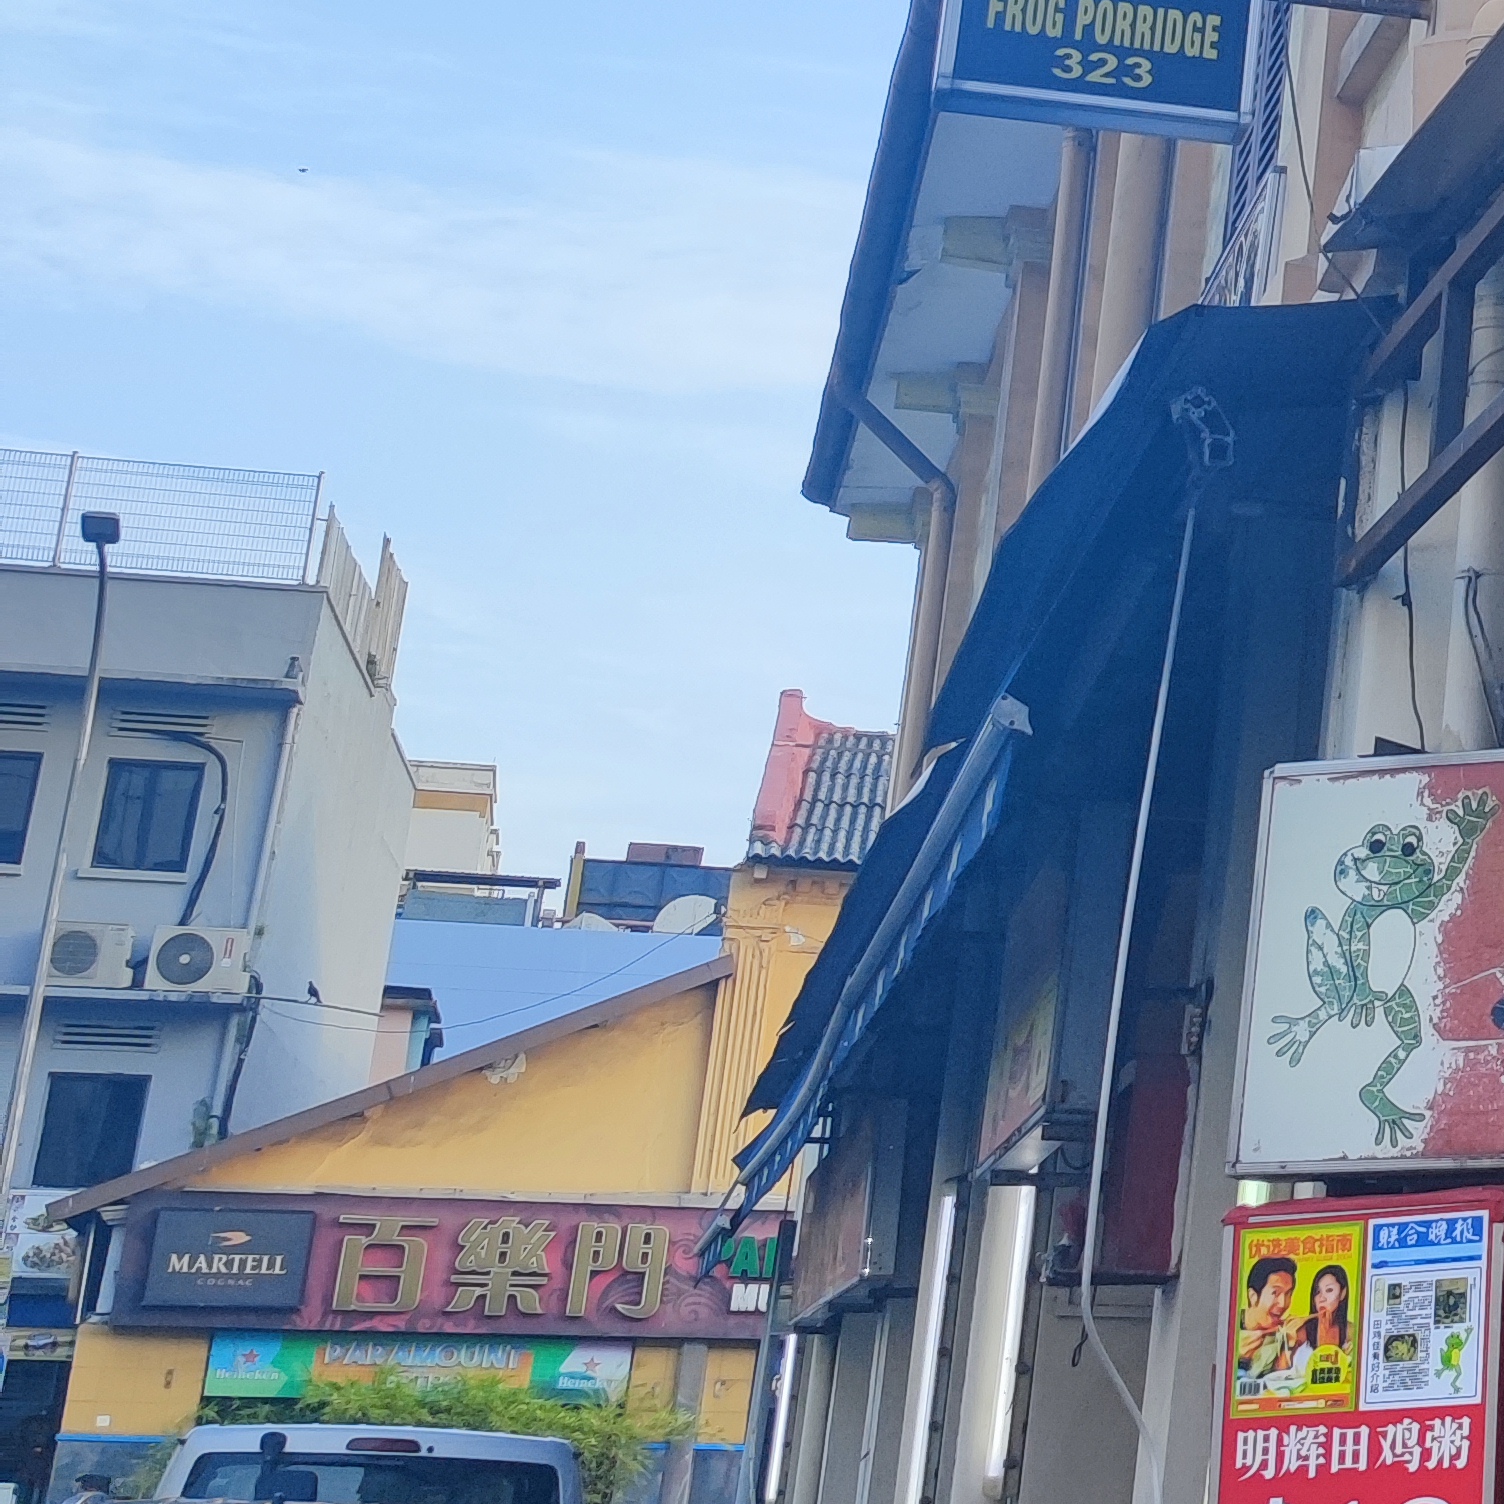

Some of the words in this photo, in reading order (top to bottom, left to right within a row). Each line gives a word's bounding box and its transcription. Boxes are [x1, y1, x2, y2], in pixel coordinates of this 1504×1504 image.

[1050, 45, 1154, 89] 323
[1247, 1233, 1354, 1259] 优选美食指南
[166, 1252, 288, 1276] MARTELL
[331, 1213, 671, 1319] 百樂門
[323, 1340, 523, 1370] PARAMOUNT
[215, 1366, 280, 1382] Heineken
[1233, 1415, 1472, 1481] 明辉田鸡粥
